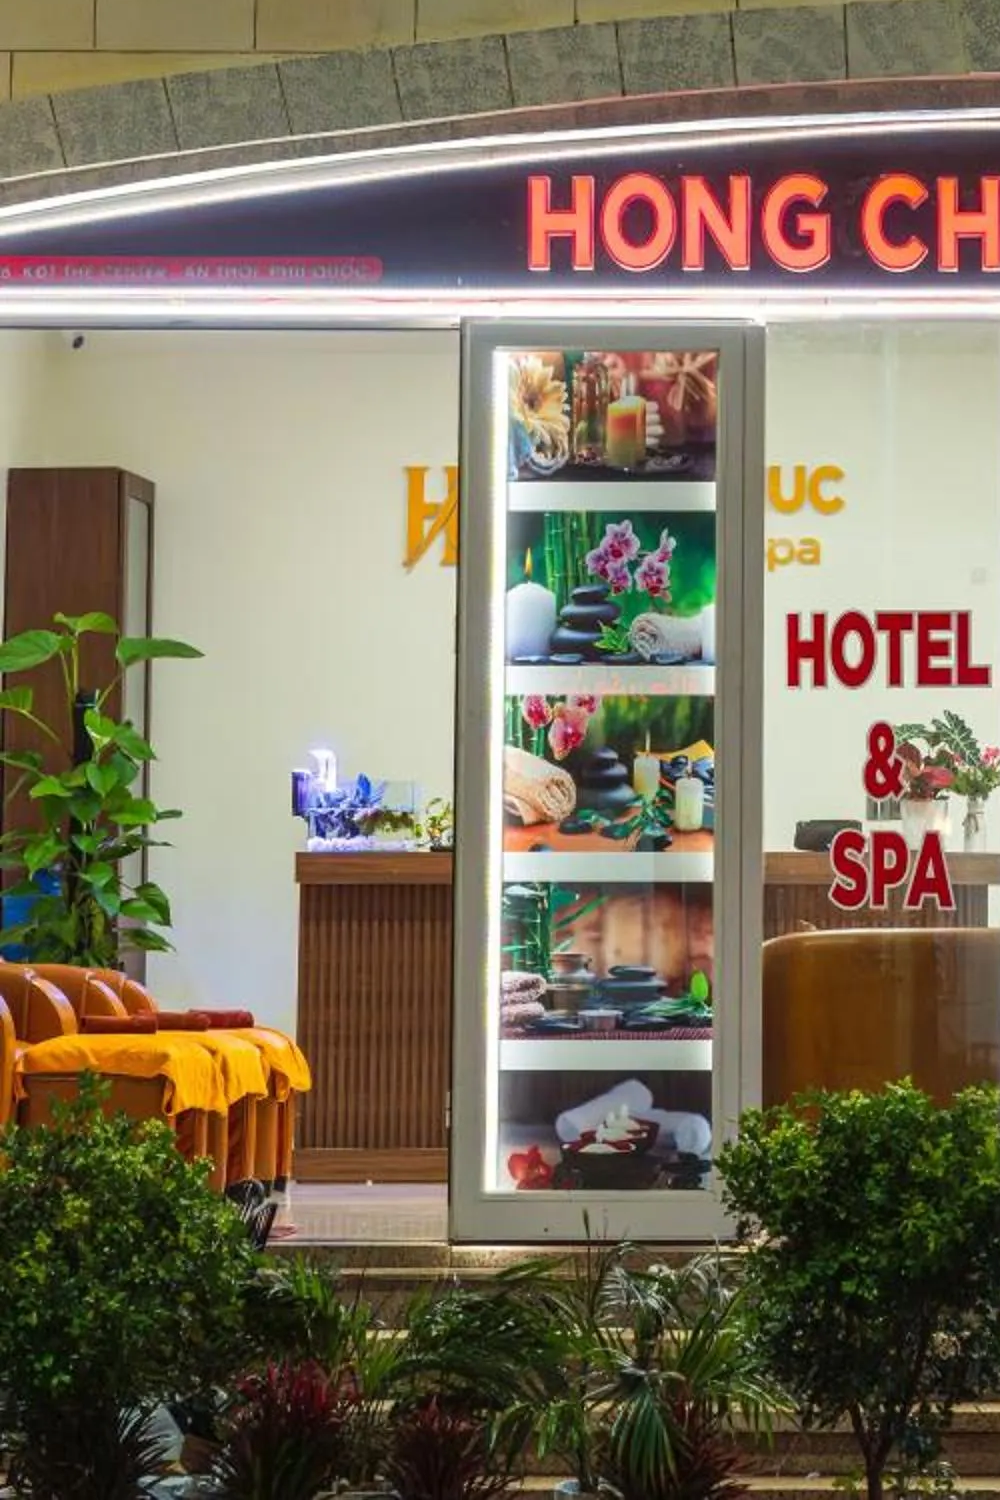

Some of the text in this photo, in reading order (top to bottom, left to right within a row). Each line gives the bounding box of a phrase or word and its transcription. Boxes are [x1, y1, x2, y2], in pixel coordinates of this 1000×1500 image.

[526, 172, 831, 273] HONG
[766, 537, 822, 573] pa
[786, 610, 991, 688] HOTEL
[863, 721, 902, 800] &
[829, 830, 955, 911] SPA
